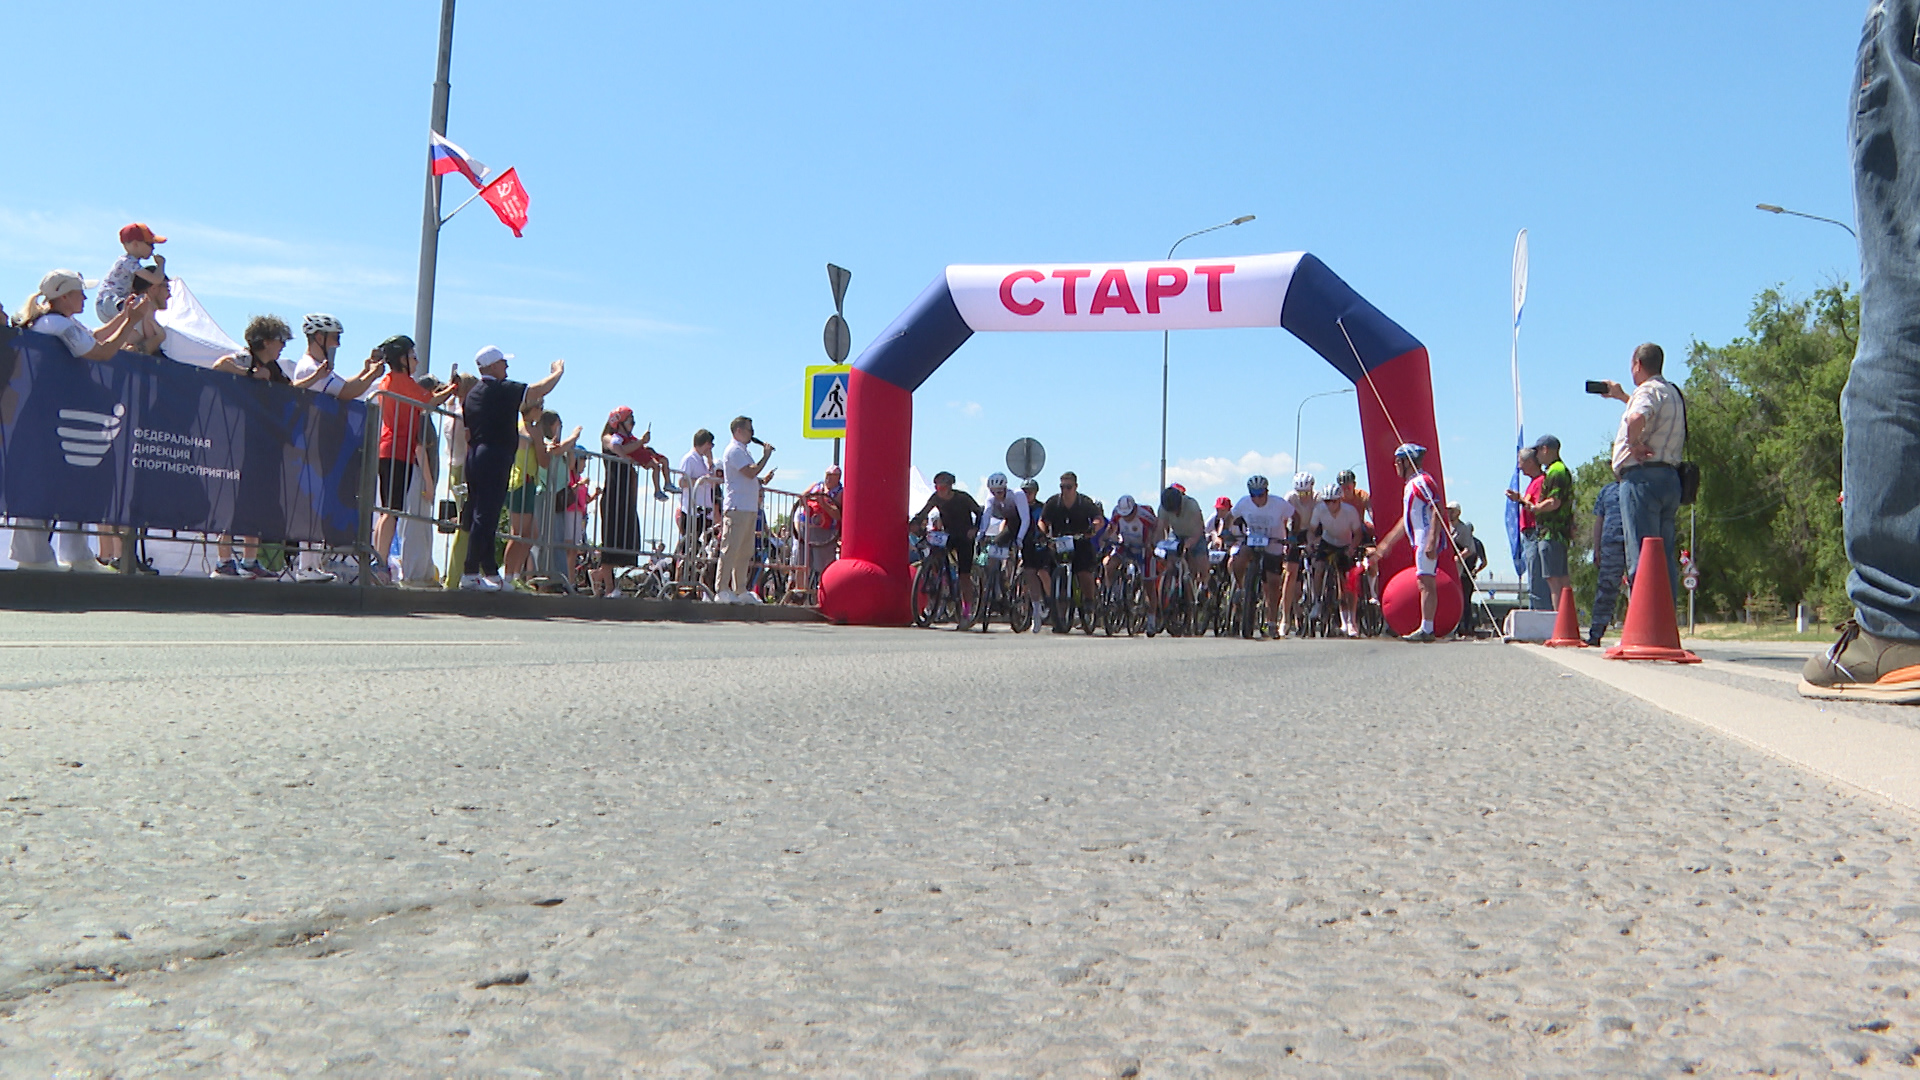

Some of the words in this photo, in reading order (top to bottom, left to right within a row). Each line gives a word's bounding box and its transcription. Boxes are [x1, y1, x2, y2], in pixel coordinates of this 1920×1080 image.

[999, 264, 1236, 316] СТАРТ
[133, 428, 212, 449] ФЕДЕРАЛЬНАЯ
[132, 443, 191, 460] ДИРЕКЦИЯ
[131, 457, 241, 482] СПОРТМЕРОПРИЯТИЙ
